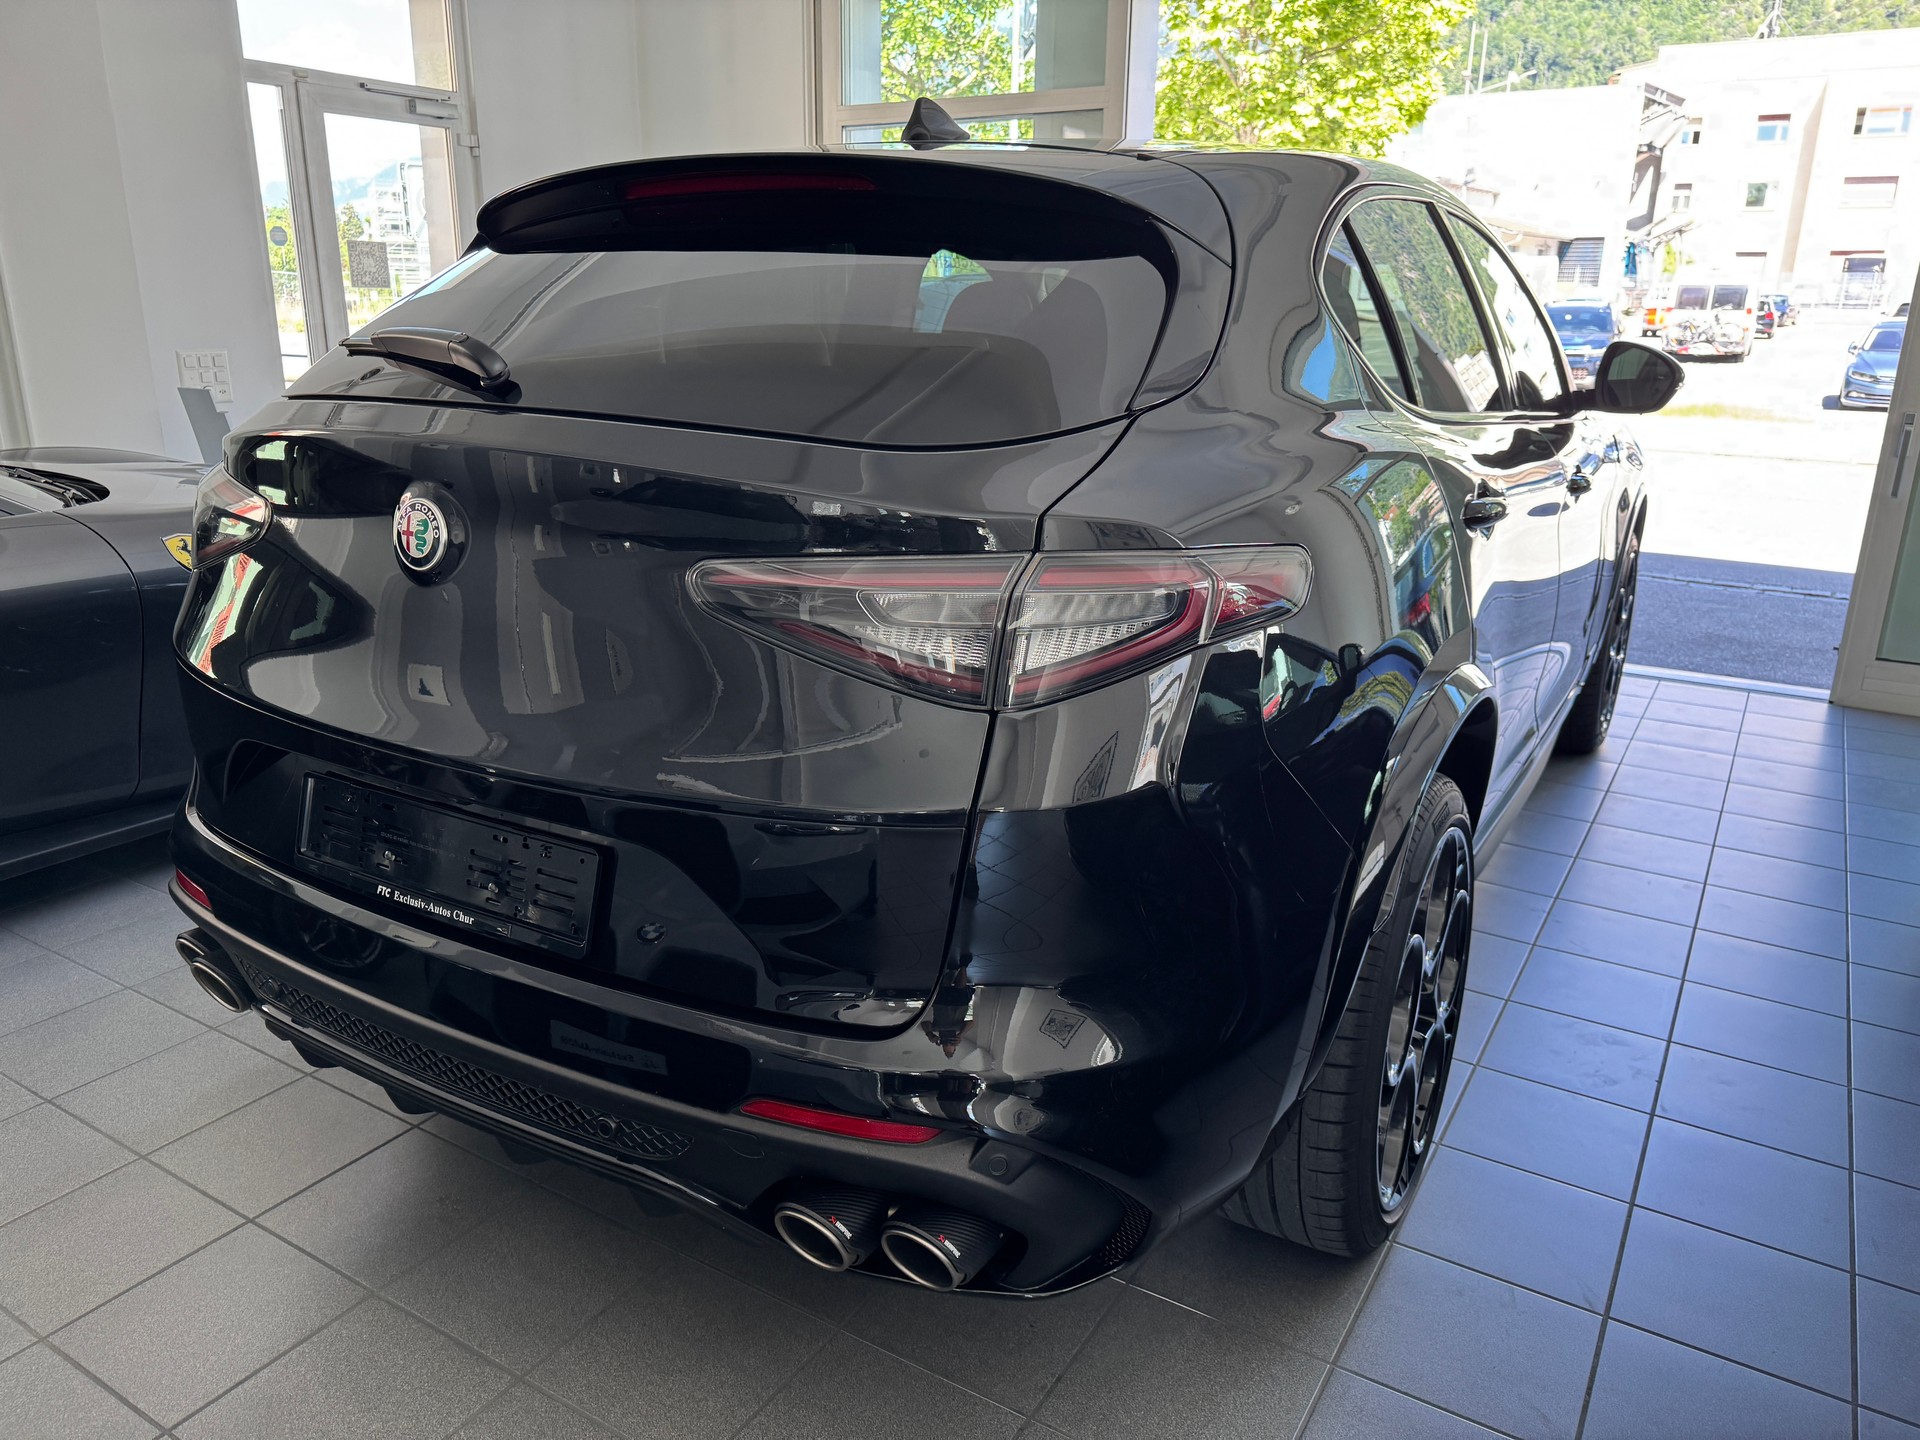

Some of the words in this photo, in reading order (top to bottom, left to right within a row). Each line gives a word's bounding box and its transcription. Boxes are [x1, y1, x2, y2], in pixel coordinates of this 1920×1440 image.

[415, 503, 440, 538] ROMEO
[377, 885, 392, 898] FTC
[393, 890, 451, 918] Exclusiv-Autos
[453, 910, 475, 925] Chur
